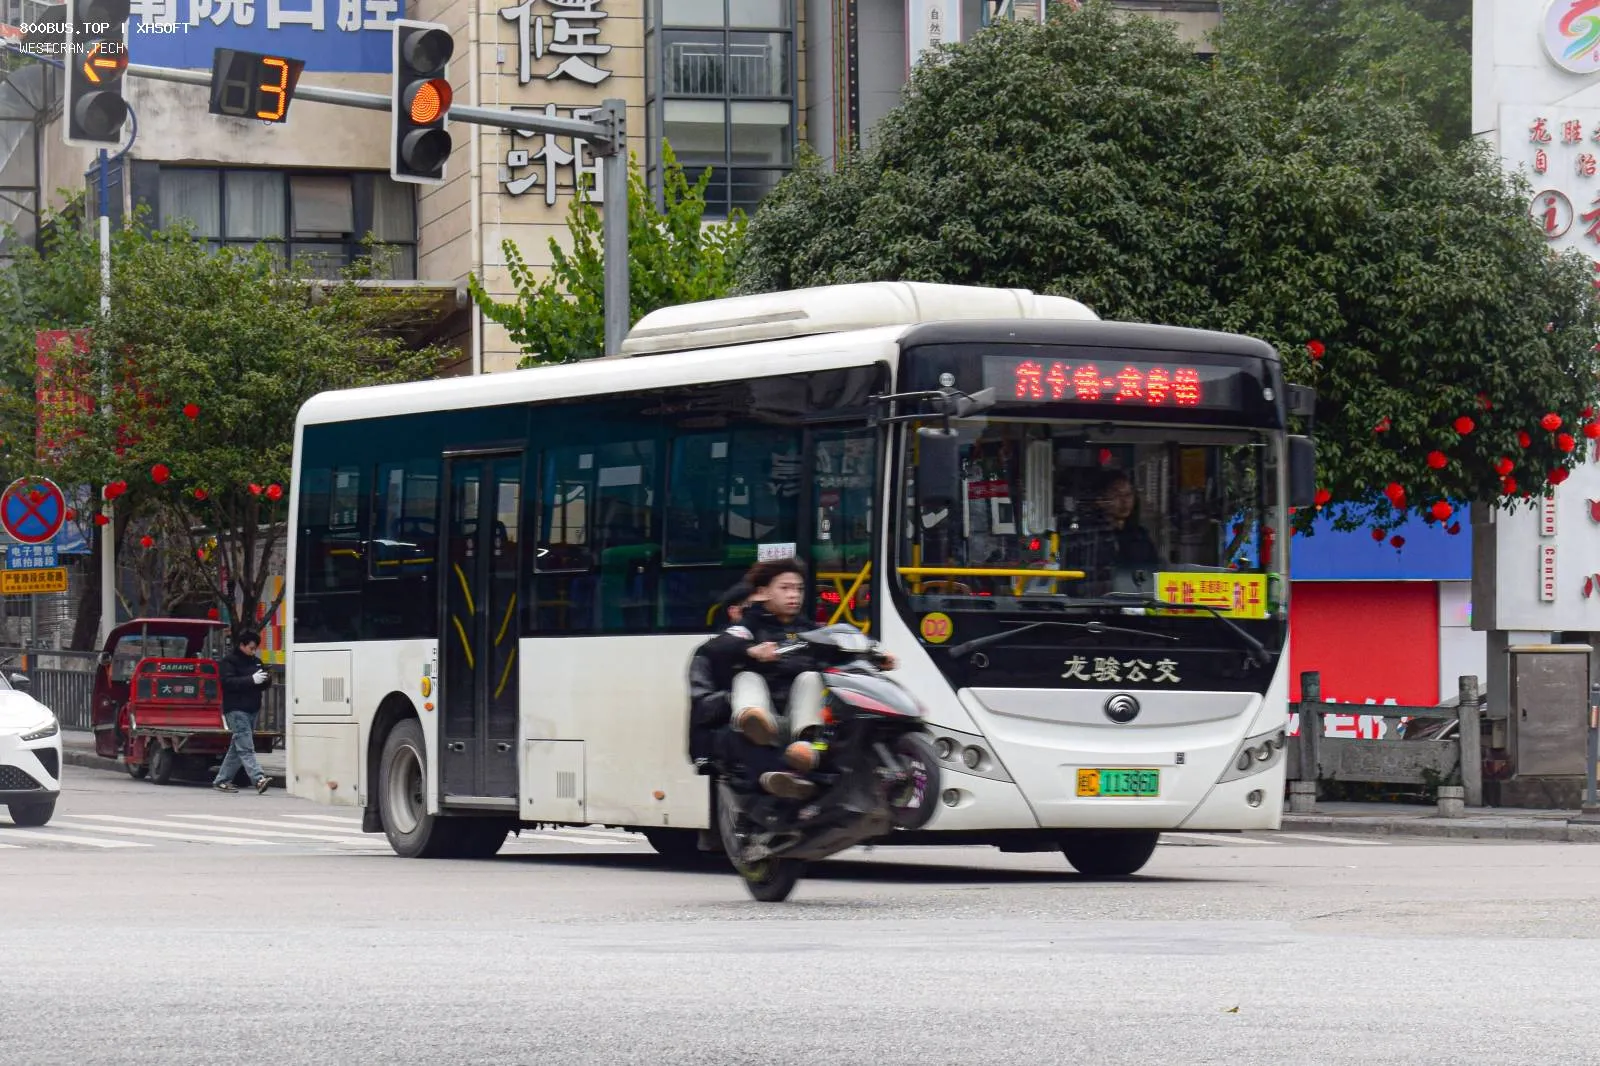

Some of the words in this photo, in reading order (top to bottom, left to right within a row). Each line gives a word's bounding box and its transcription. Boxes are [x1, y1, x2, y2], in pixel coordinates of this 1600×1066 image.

[257, 56, 289, 121] 3
[1529, 117, 1600, 144] 龙胜
[925, 618, 947, 637] D2
[1061, 655, 1182, 682] 龙骏公交
